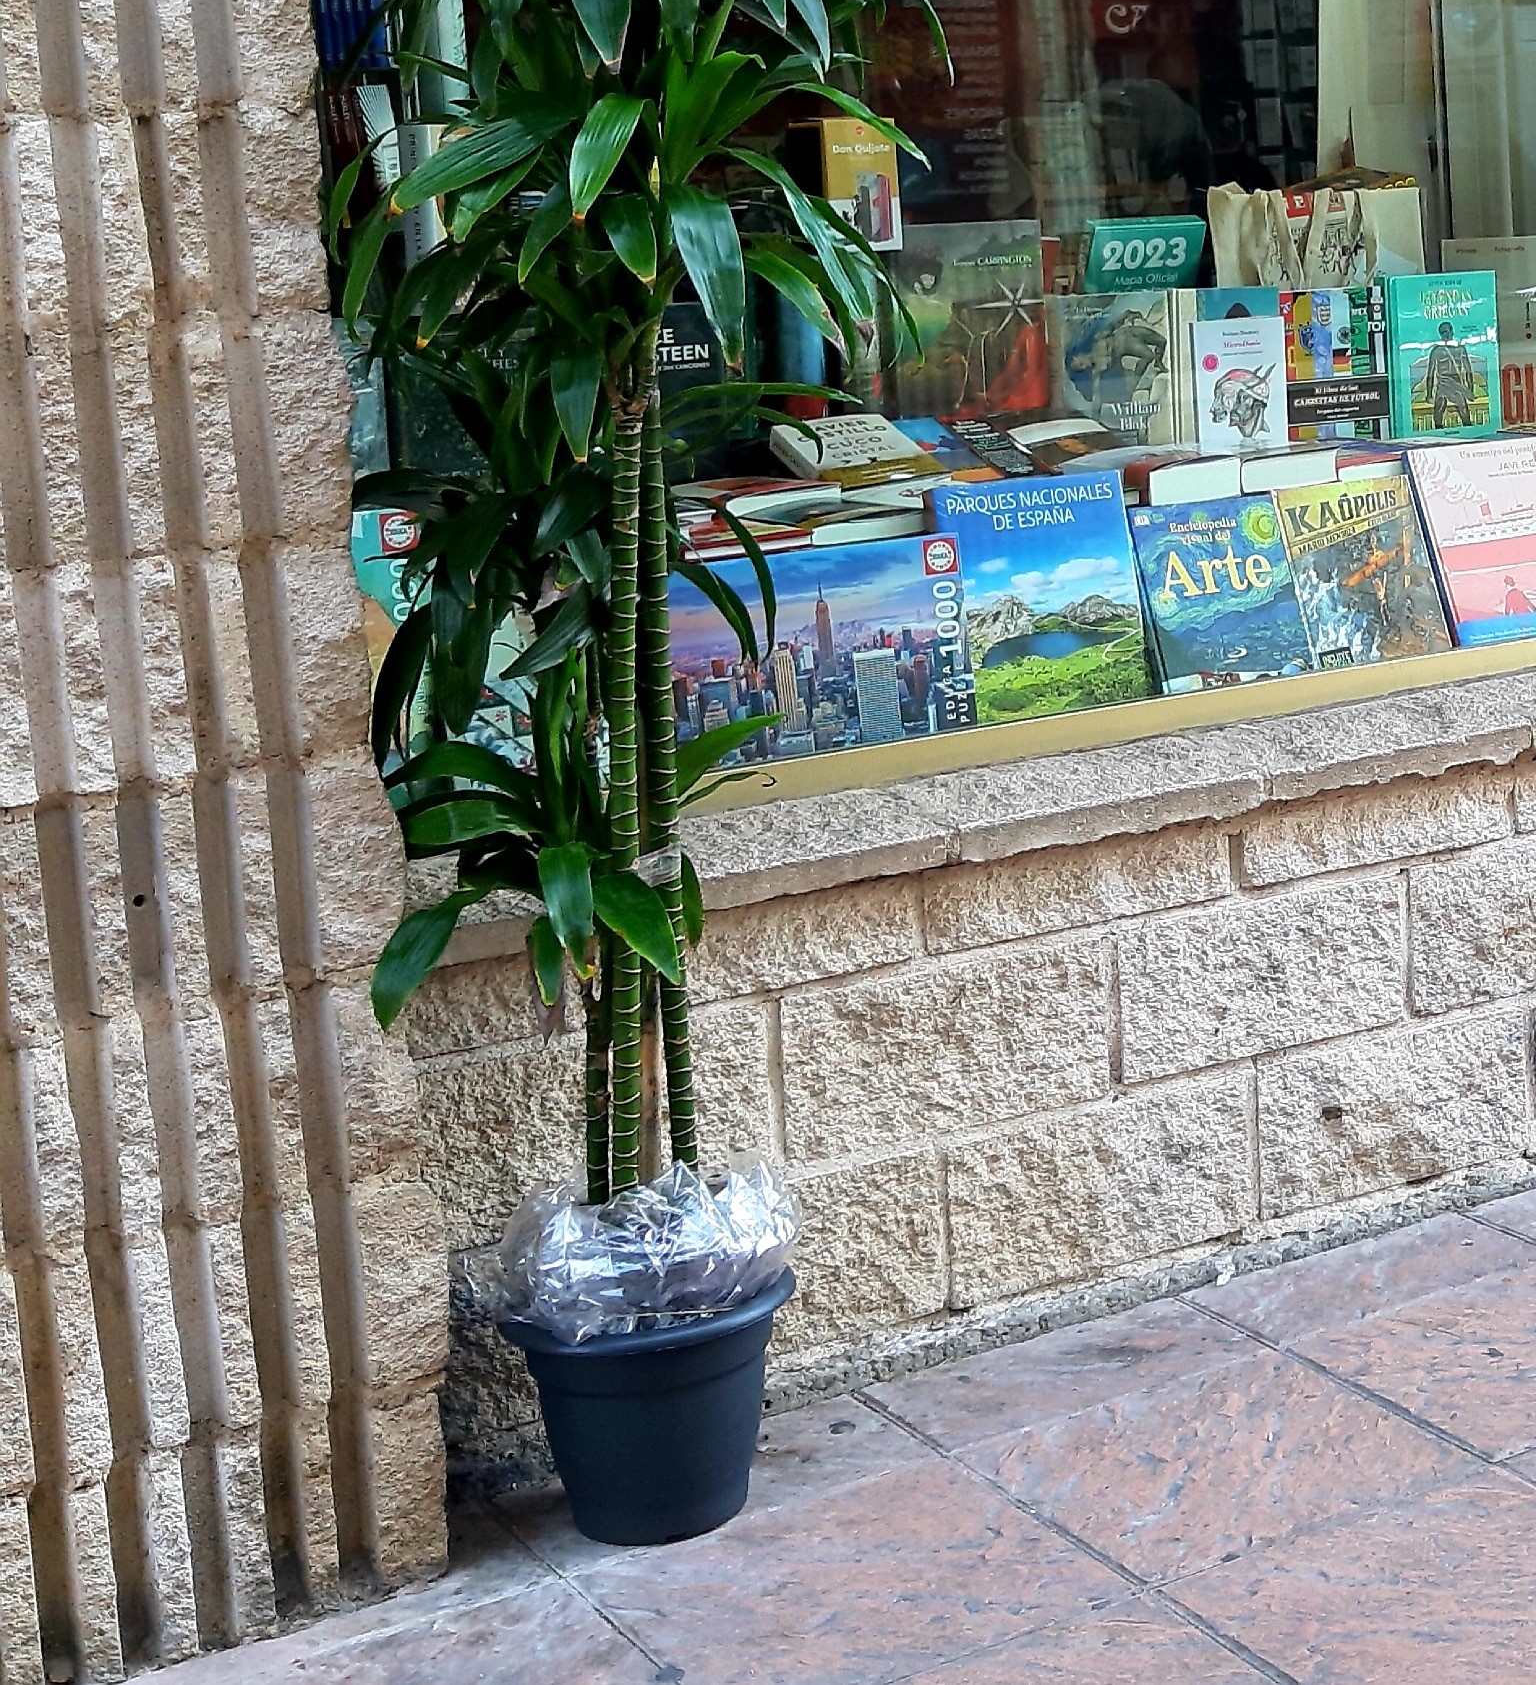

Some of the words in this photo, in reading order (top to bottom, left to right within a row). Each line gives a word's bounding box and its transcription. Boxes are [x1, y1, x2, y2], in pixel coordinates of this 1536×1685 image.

[1101, 236, 1187, 271] 2023
[1114, 275, 1143, 291] Mapa
[945, 492, 1016, 516] PARQUES
[1018, 480, 1113, 509] NACIONALES
[1285, 489, 1398, 540] KAÓPOLIS
[993, 510, 1015, 533] DE
[1018, 504, 1076, 530] ESPAÑA
[1169, 516, 1237, 534] Enciclopedia
[1162, 545, 1273, 602] Arte
[932, 580, 963, 658] 1000
